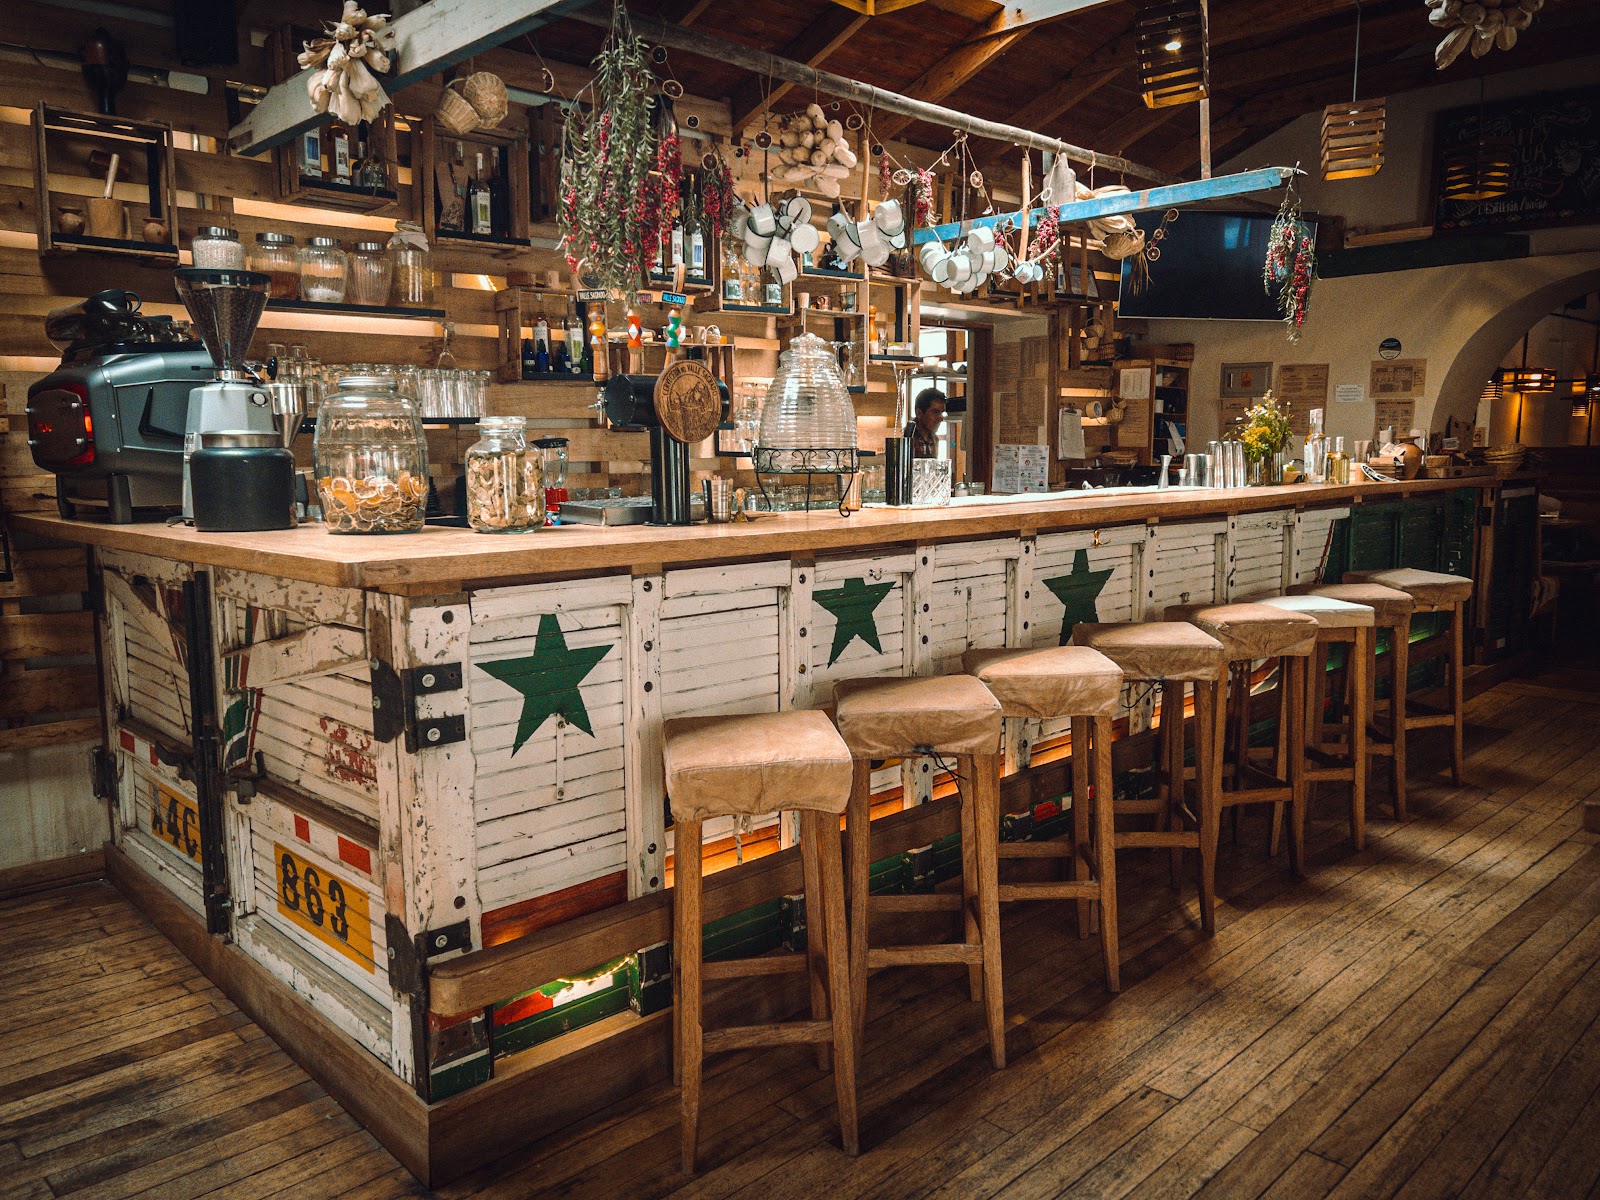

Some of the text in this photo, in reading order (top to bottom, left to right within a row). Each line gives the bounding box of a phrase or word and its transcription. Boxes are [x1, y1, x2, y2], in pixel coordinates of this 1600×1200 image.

[687, 364, 701, 374] VALLE
[702, 370, 719, 397] SAGRADO
[281, 853, 349, 942] 863
